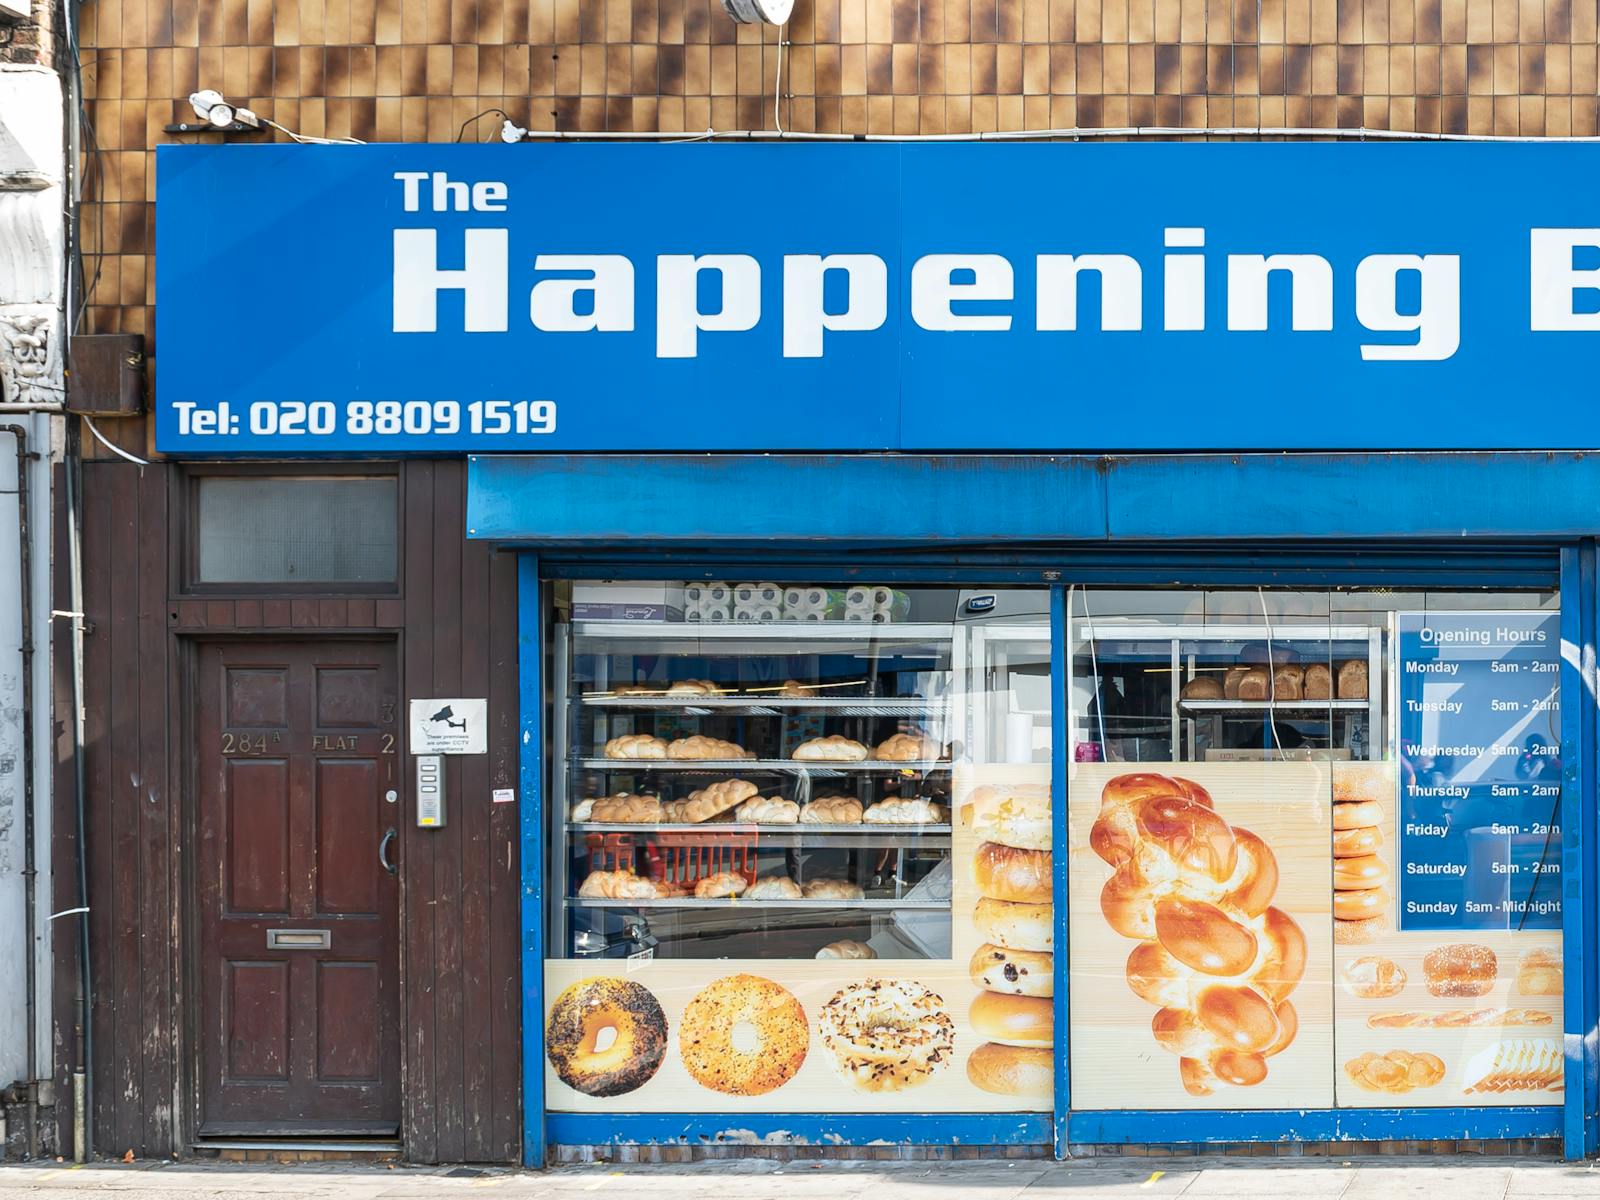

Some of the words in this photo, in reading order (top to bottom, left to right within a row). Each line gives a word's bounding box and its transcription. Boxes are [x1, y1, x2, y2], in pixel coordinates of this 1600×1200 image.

[394, 172, 508, 212] The
[393, 228, 1461, 361] Happening
[173, 401, 239, 435] Tel:
[250, 401, 336, 435] 020
[346, 401, 460, 435] 8809
[468, 401, 557, 434] 1519
[1420, 627, 1491, 645] Opening
[1496, 628, 1546, 642] Hours
[1406, 661, 1459, 675] Monday
[1491, 661, 1519, 672] 5am
[1531, 661, 1560, 672] 2am
[380, 703, 395, 724] 3
[1406, 700, 1463, 714] Tuesday
[1491, 699, 1519, 711] 5am
[1531, 699, 1560, 711] 2am
[312, 735, 359, 752] FLAT
[381, 733, 395, 754] 2
[1406, 745, 1485, 759] Wednesday
[1491, 744, 1519, 755] 5am
[1531, 744, 1560, 755] 2am
[1406, 785, 1471, 799] Thursday
[1491, 784, 1519, 796] 5am
[1531, 784, 1560, 796] 2am
[1406, 823, 1449, 838] Friday
[1491, 823, 1519, 834] 5am
[1531, 823, 1560, 834] 2am
[1406, 863, 1467, 876] Saturday
[1491, 862, 1519, 873] 5am
[1531, 862, 1560, 873] 2am
[1406, 902, 1458, 915] Sunday
[1465, 901, 1493, 912] 5am
[1502, 901, 1561, 915] Midnight
